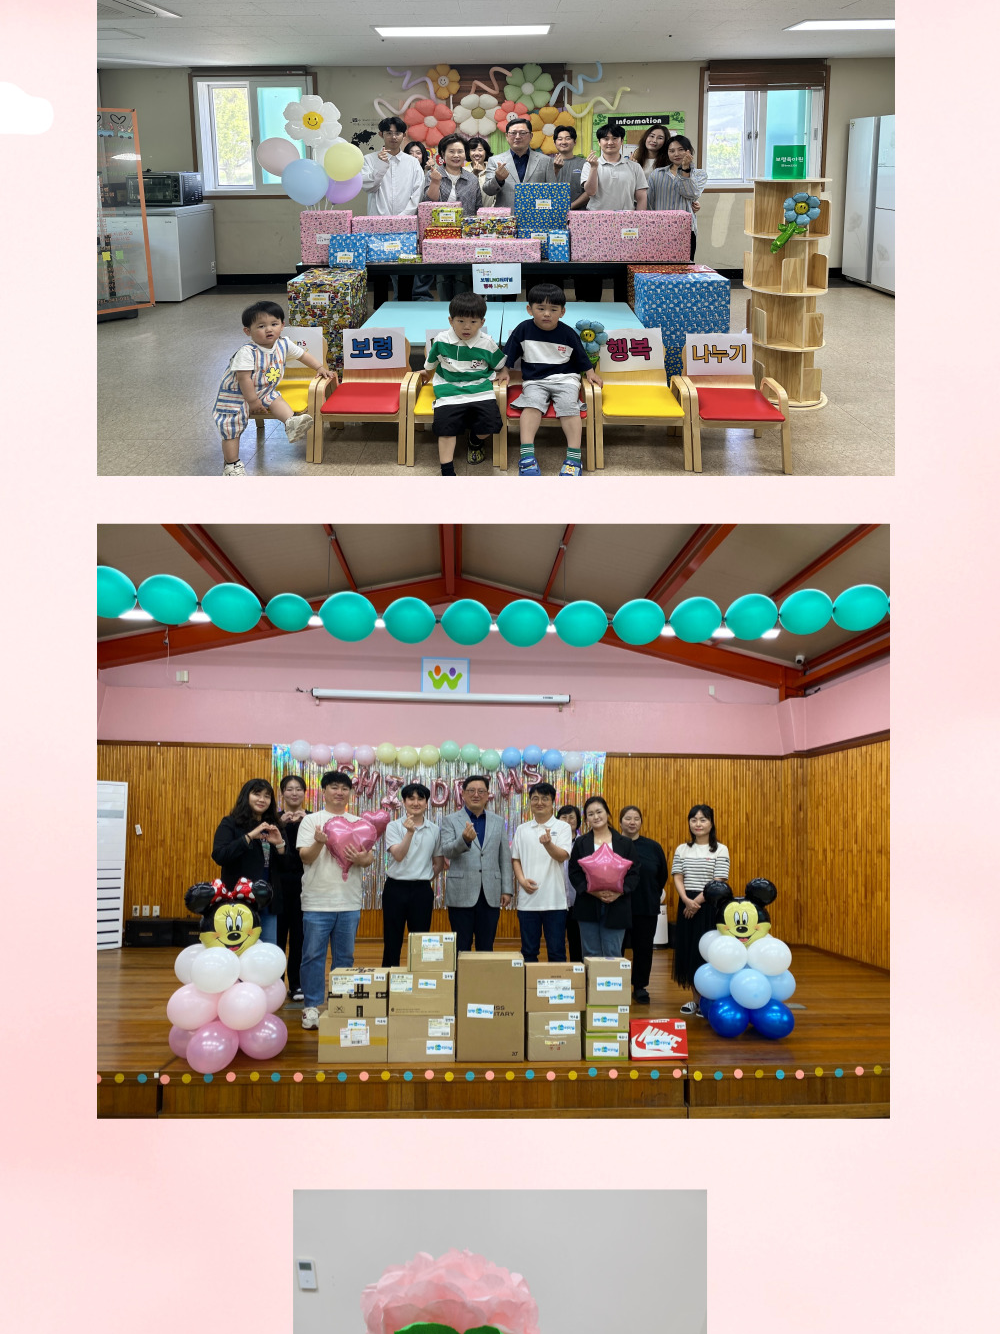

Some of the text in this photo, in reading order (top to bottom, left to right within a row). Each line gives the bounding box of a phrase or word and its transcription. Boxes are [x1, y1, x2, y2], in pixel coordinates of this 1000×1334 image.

[350, 335, 394, 360] 보령
[606, 337, 652, 362] 행복
[691, 343, 747, 364] 나누기
